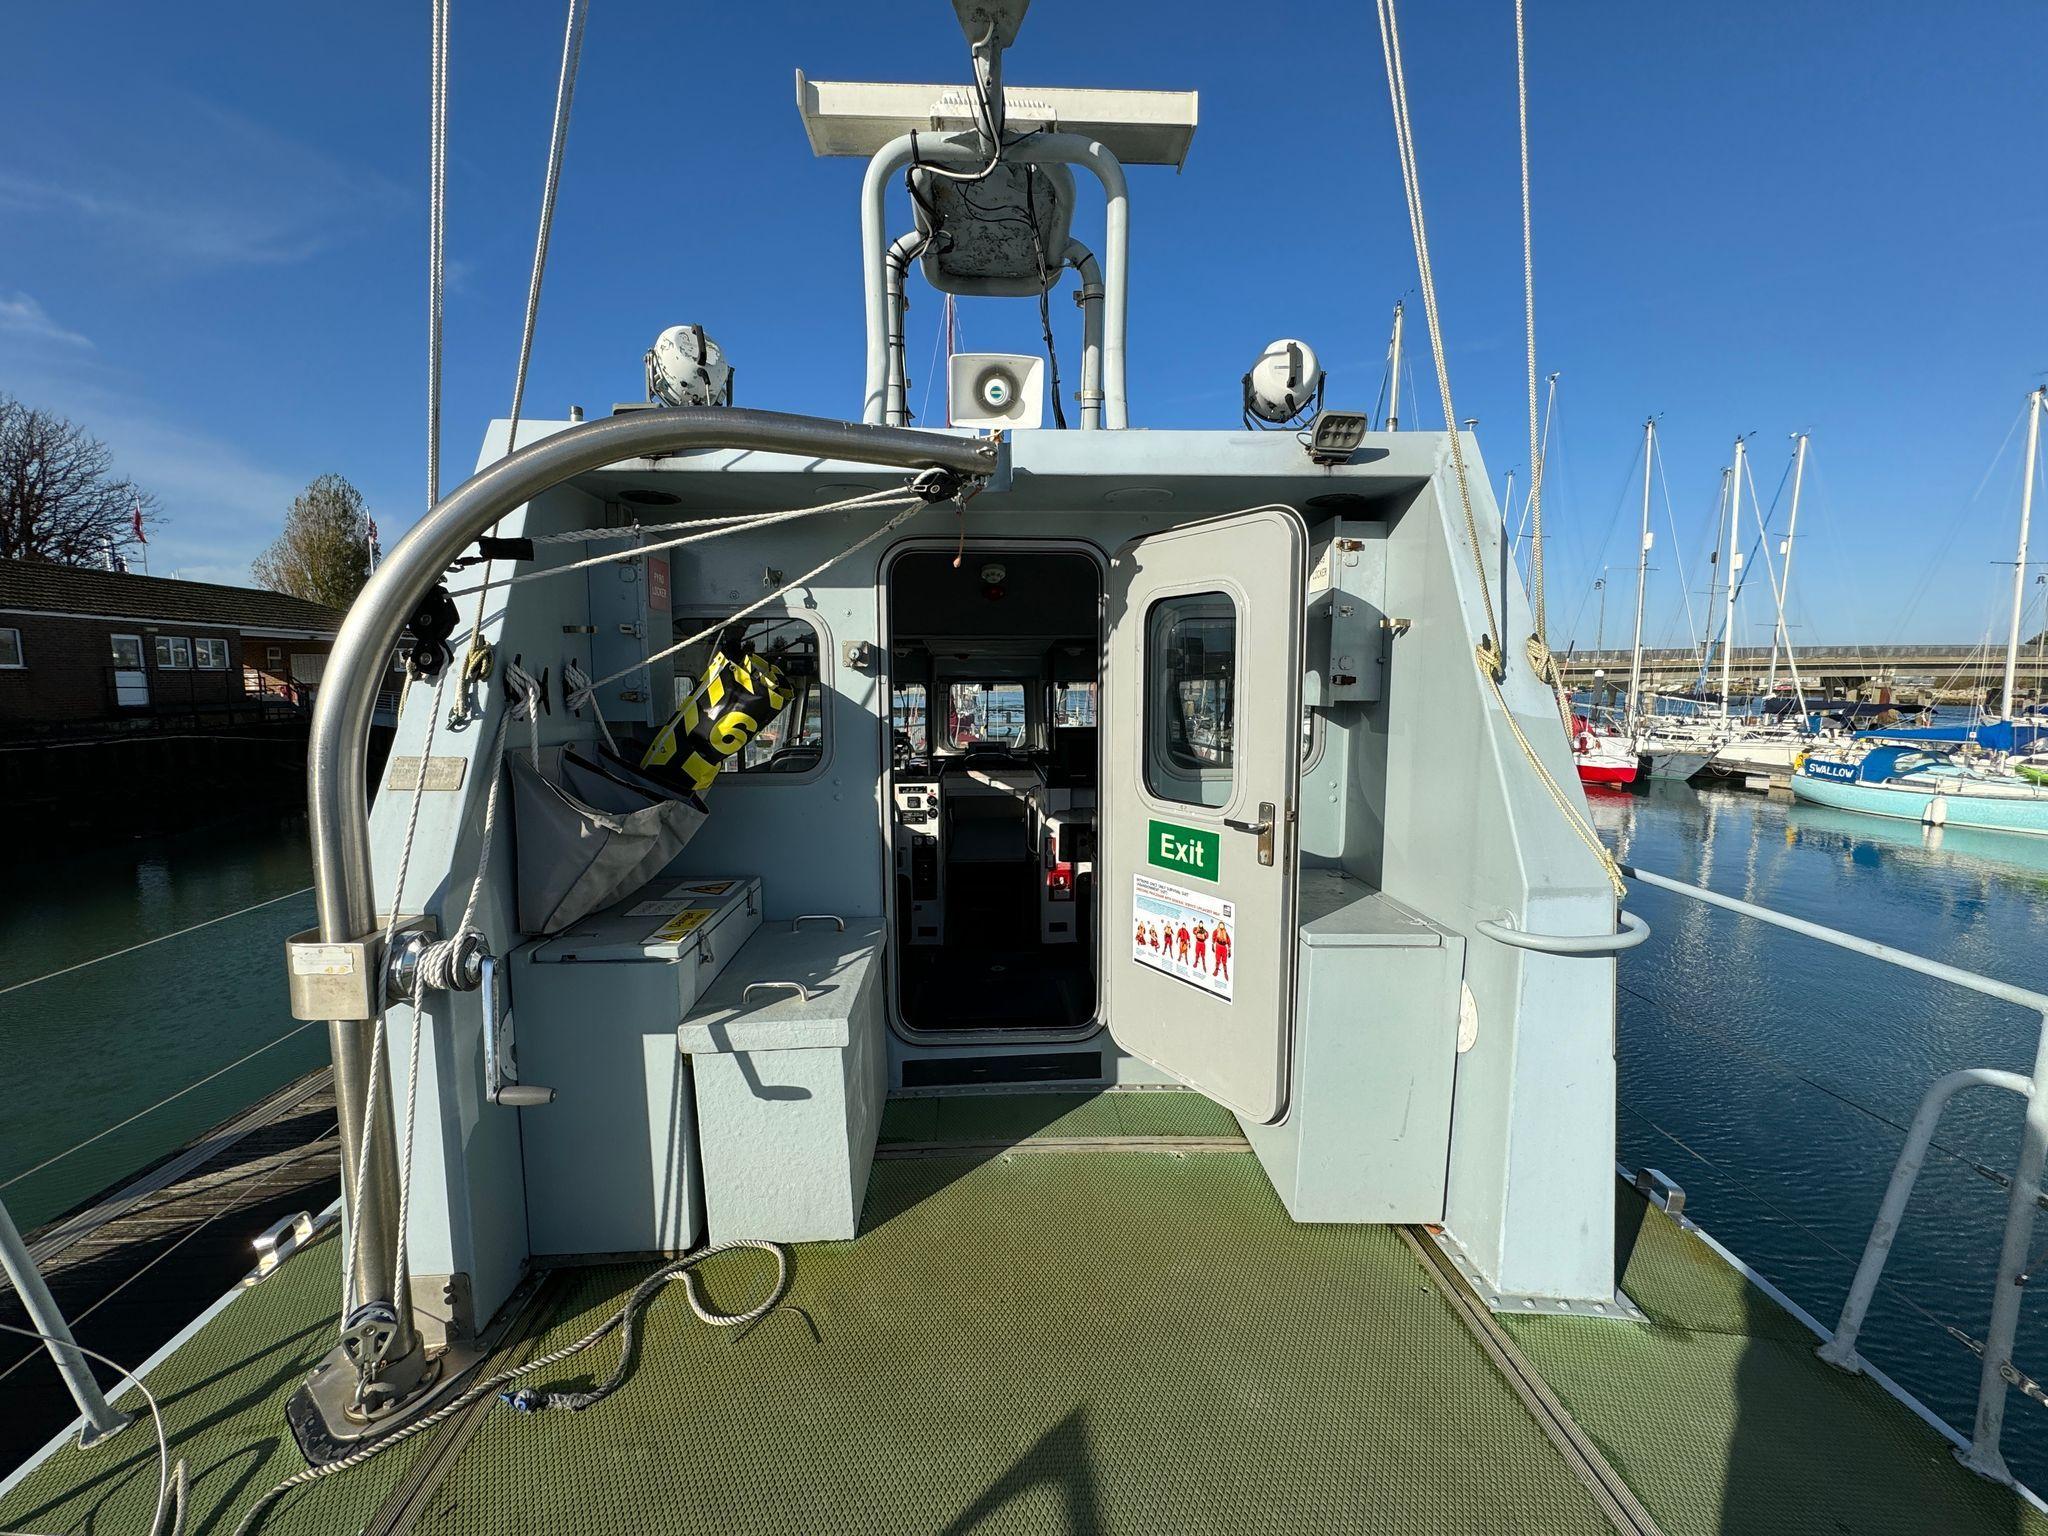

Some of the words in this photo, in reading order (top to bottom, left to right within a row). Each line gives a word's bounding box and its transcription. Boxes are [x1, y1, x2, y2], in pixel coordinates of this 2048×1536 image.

[709, 711, 758, 755] 6
[1809, 763, 1854, 778] SWALLOW
[1161, 832, 1204, 867] Exit
